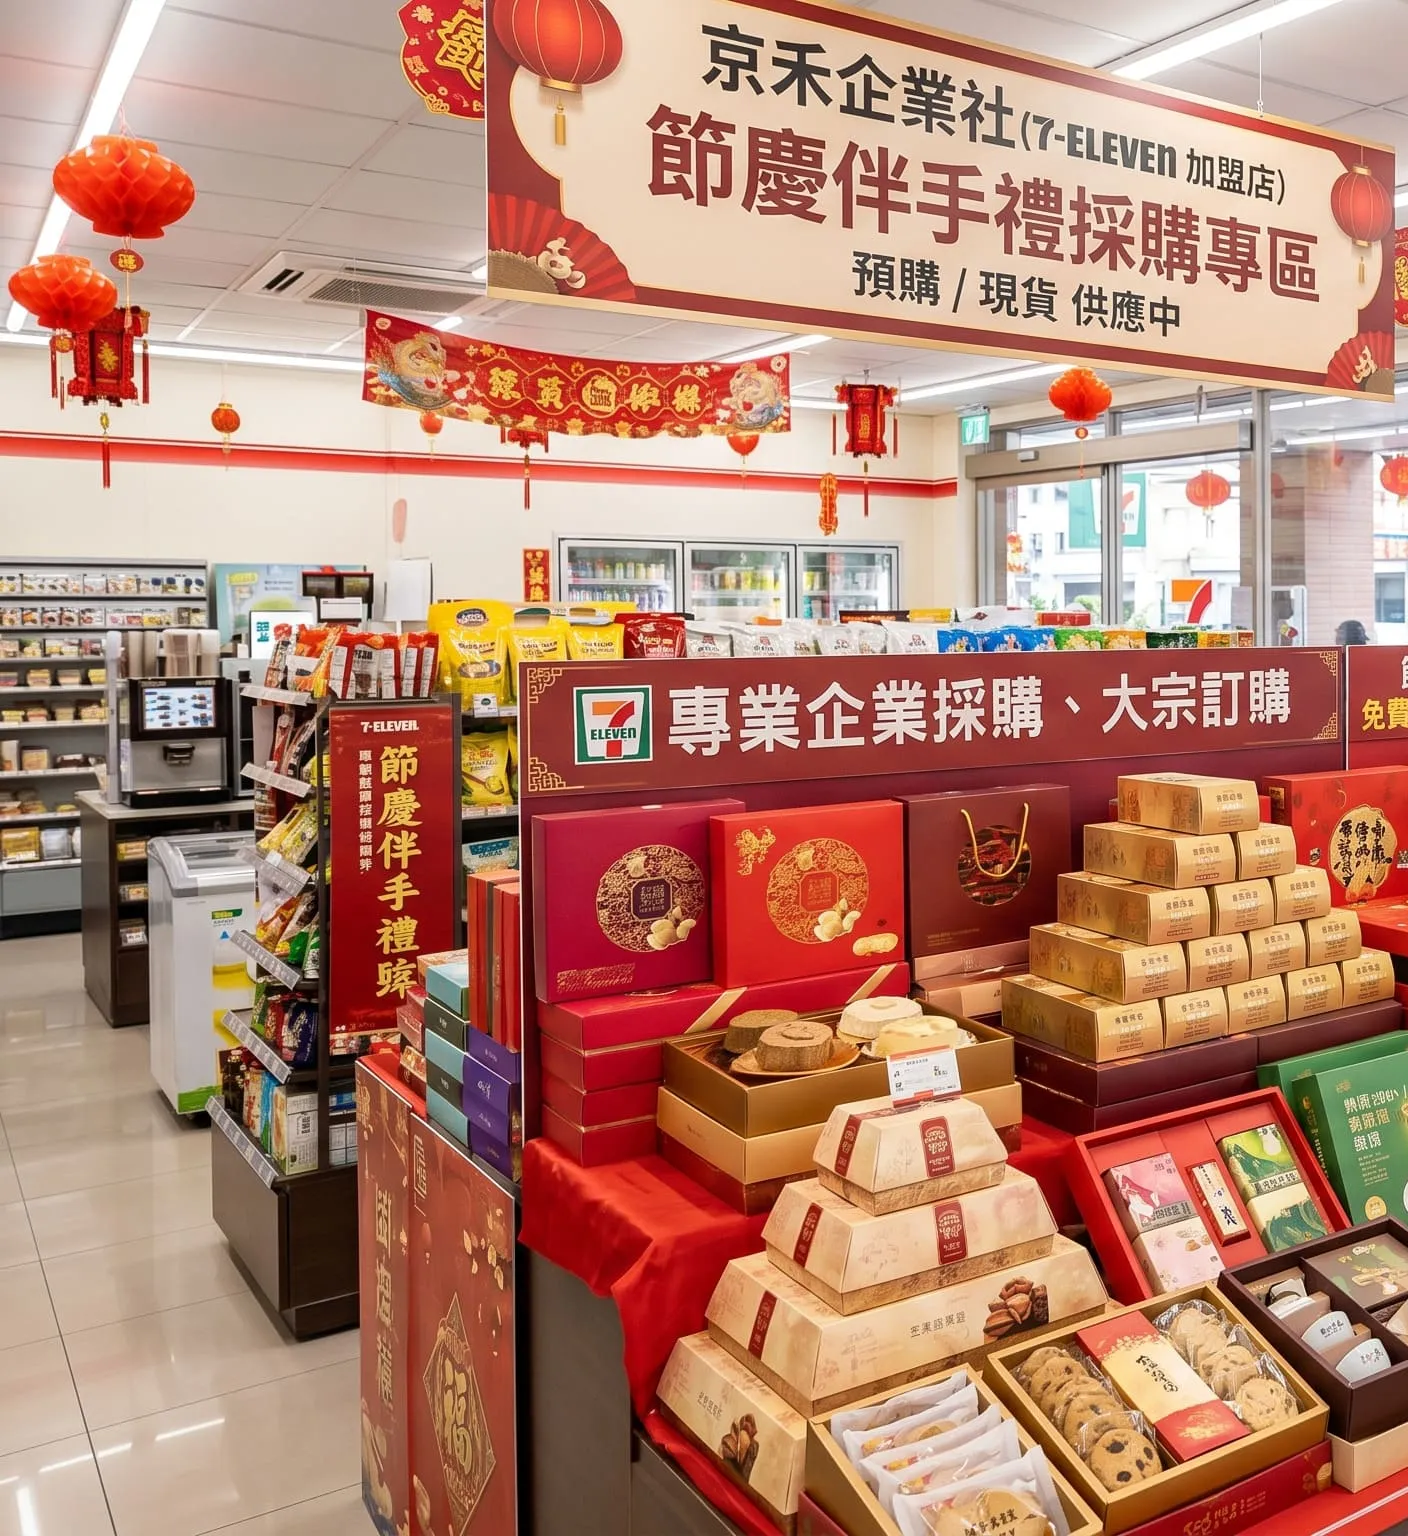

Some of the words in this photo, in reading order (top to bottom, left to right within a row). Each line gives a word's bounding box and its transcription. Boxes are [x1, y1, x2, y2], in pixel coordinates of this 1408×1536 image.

[646, 104, 1320, 302] 節慶伴手禮採購專區
[1186, 149, 1285, 205] 加盟店)
[852, 250, 941, 306] 預購
[979, 270, 1058, 323] 現貨
[1071, 283, 1181, 337] 供應中
[668, 667, 1291, 757] 專業企業採購、大宗訂購
